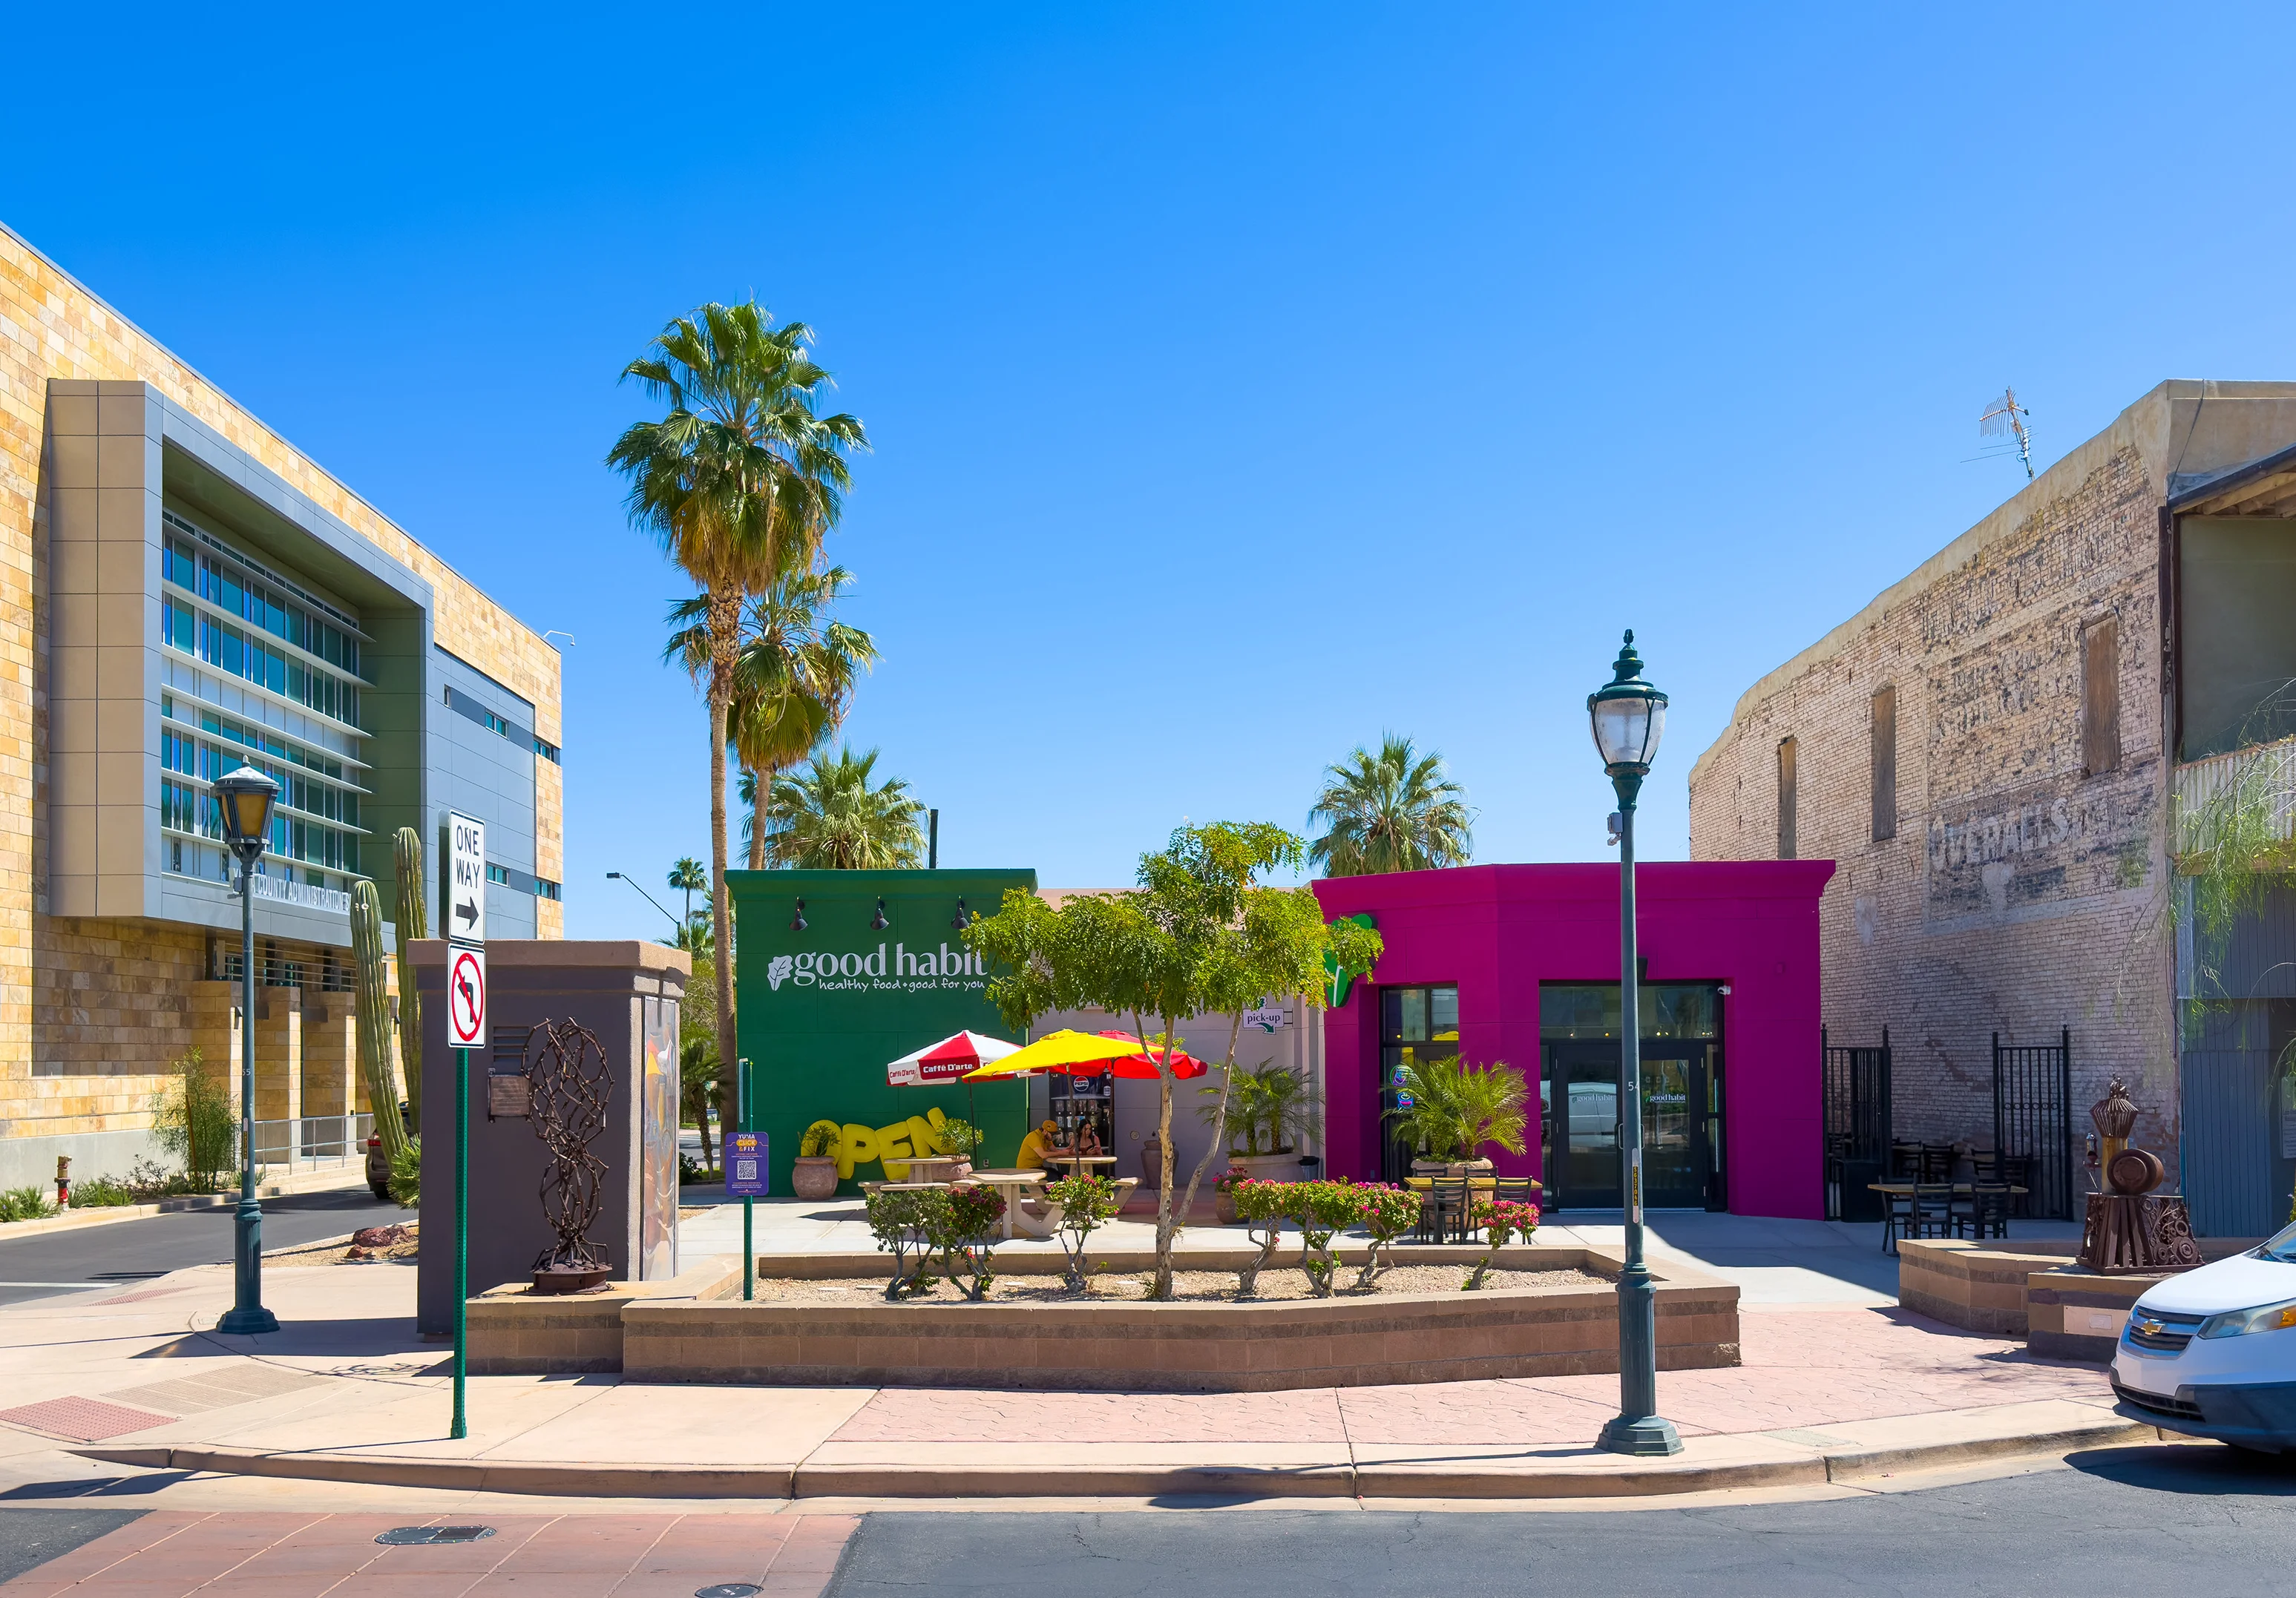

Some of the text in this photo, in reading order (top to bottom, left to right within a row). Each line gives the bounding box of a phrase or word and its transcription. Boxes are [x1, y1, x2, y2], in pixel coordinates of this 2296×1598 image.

[456, 825, 479, 856] ONE
[456, 858, 480, 889] WAY
[258, 875, 286, 899] COUNTY
[289, 881, 344, 910] ADMINISTRATION
[793, 942, 988, 986] good habit
[819, 978, 985, 993] healthy food good for you
[1247, 1013, 1280, 1024] pick-up
[1577, 1095, 1595, 1103] good
[1650, 1094, 1667, 1102] good
[801, 1107, 957, 1183] OPEN
